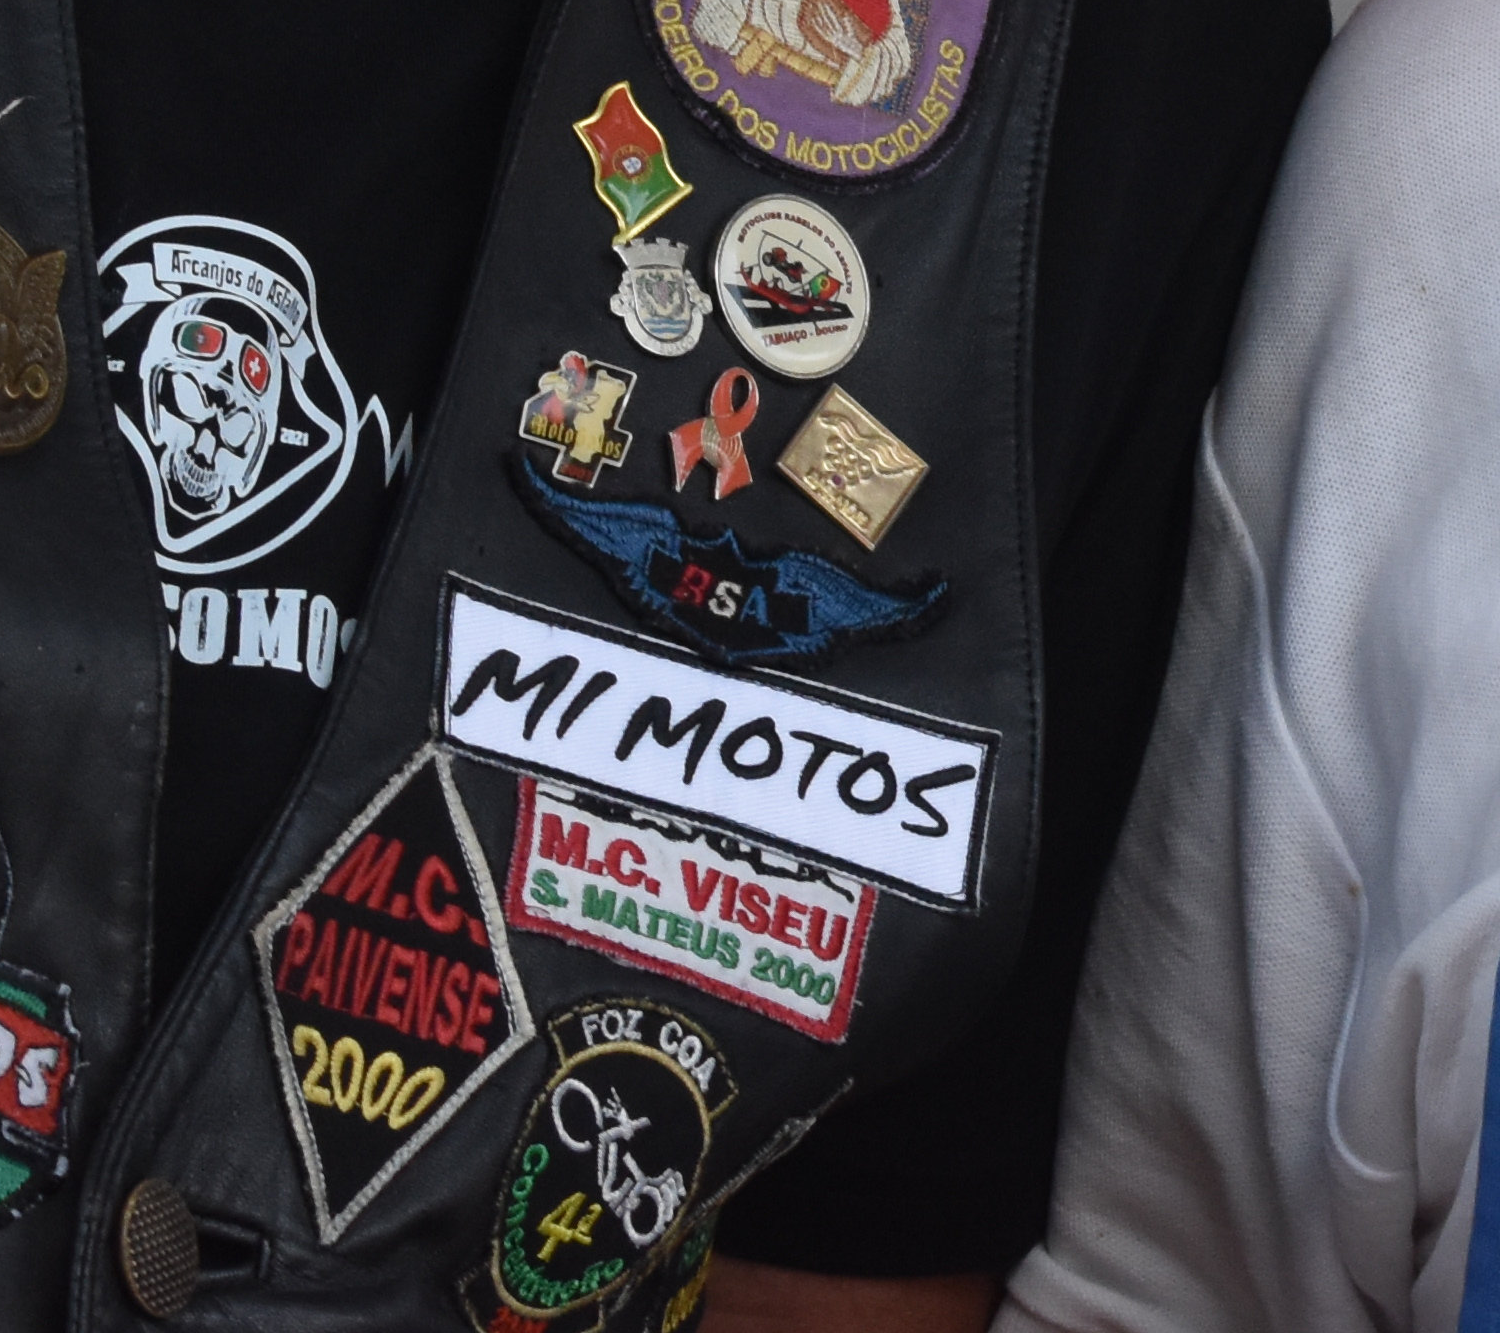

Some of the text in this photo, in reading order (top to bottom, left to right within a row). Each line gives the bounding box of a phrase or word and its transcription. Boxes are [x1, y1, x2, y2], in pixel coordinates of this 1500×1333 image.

[716, 88, 778, 152] DOS
[785, 38, 967, 172] MOTOCICLISTAS
[171, 249, 243, 288] Arcanjos
[247, 271, 263, 297] do
[737, 211, 783, 244] MOTOCLUBE
[784, 212, 824, 238] RABELOS
[761, 329, 808, 348] TABUAÇO
[161, 581, 358, 691] OMO
[451, 649, 978, 839] MI MOTOS
[319, 832, 491, 949] M.C.
[528, 867, 837, 1007] S. MATEUS 2000
[537, 811, 850, 964] M.C. VISEU
[276, 909, 502, 1059] PAIVENSE
[292, 1023, 446, 1131] 2000
[581, 1009, 717, 1094] FOZ COA
